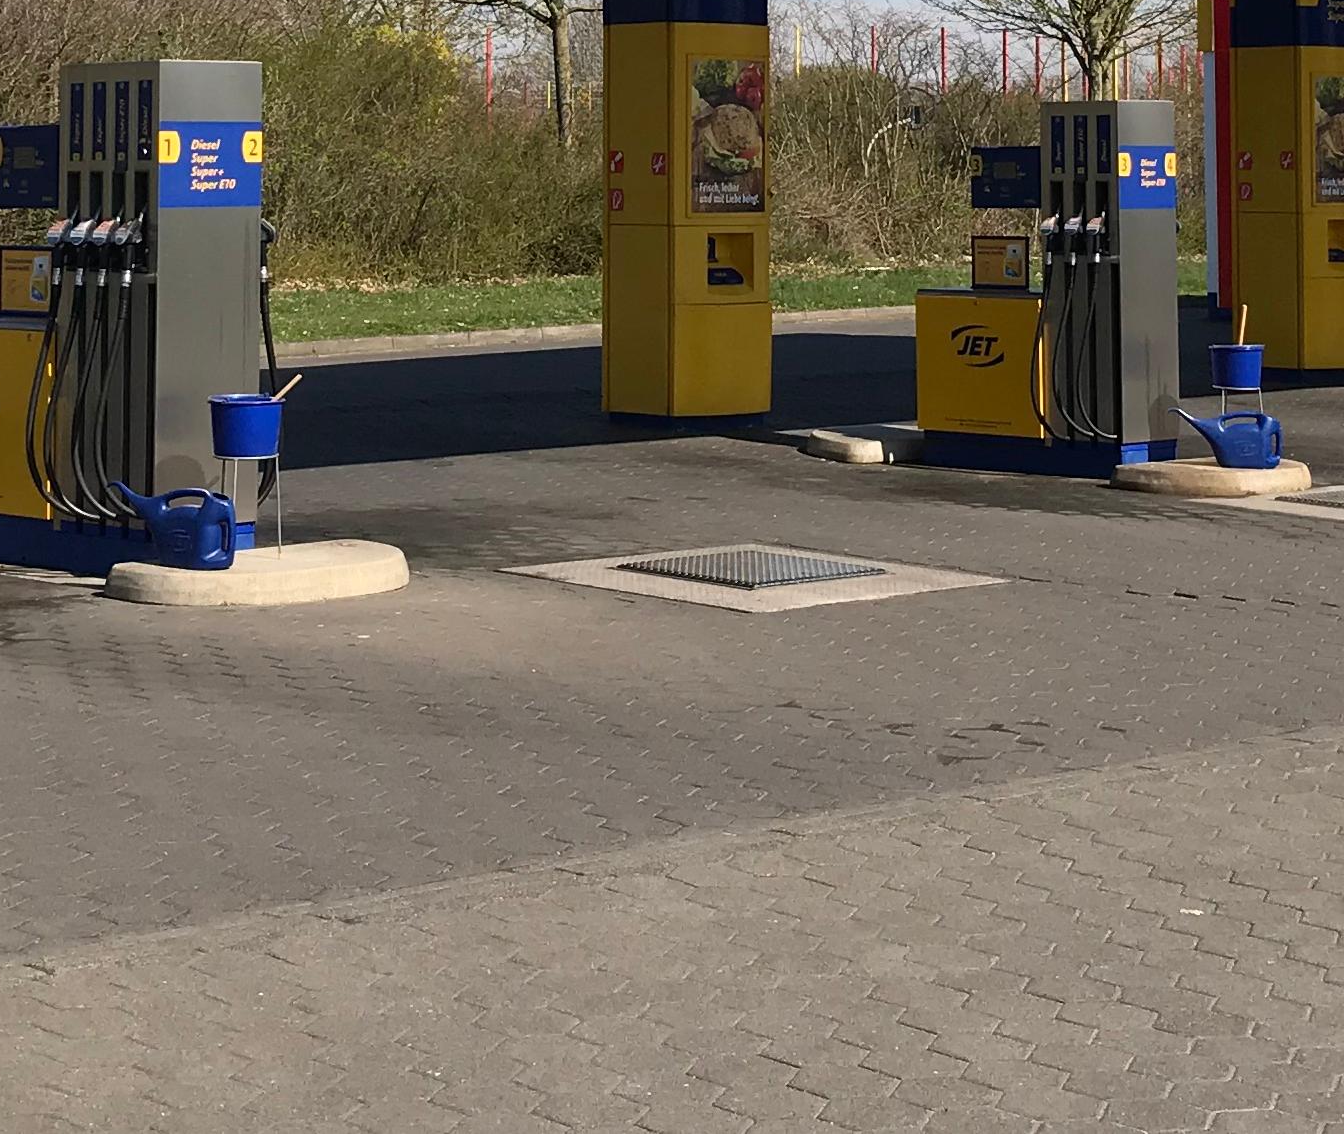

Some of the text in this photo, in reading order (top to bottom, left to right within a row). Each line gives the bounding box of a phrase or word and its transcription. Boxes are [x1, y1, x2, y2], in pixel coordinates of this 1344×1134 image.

[164, 138, 171, 157] 1
[190, 139, 221, 150] Diesel
[249, 138, 258, 156] 2
[190, 153, 219, 166] Super
[1121, 158, 1127, 172] 3
[190, 166, 225, 180] Super+
[190, 179, 236, 193] Super E10
[957, 336, 999, 356] JET
